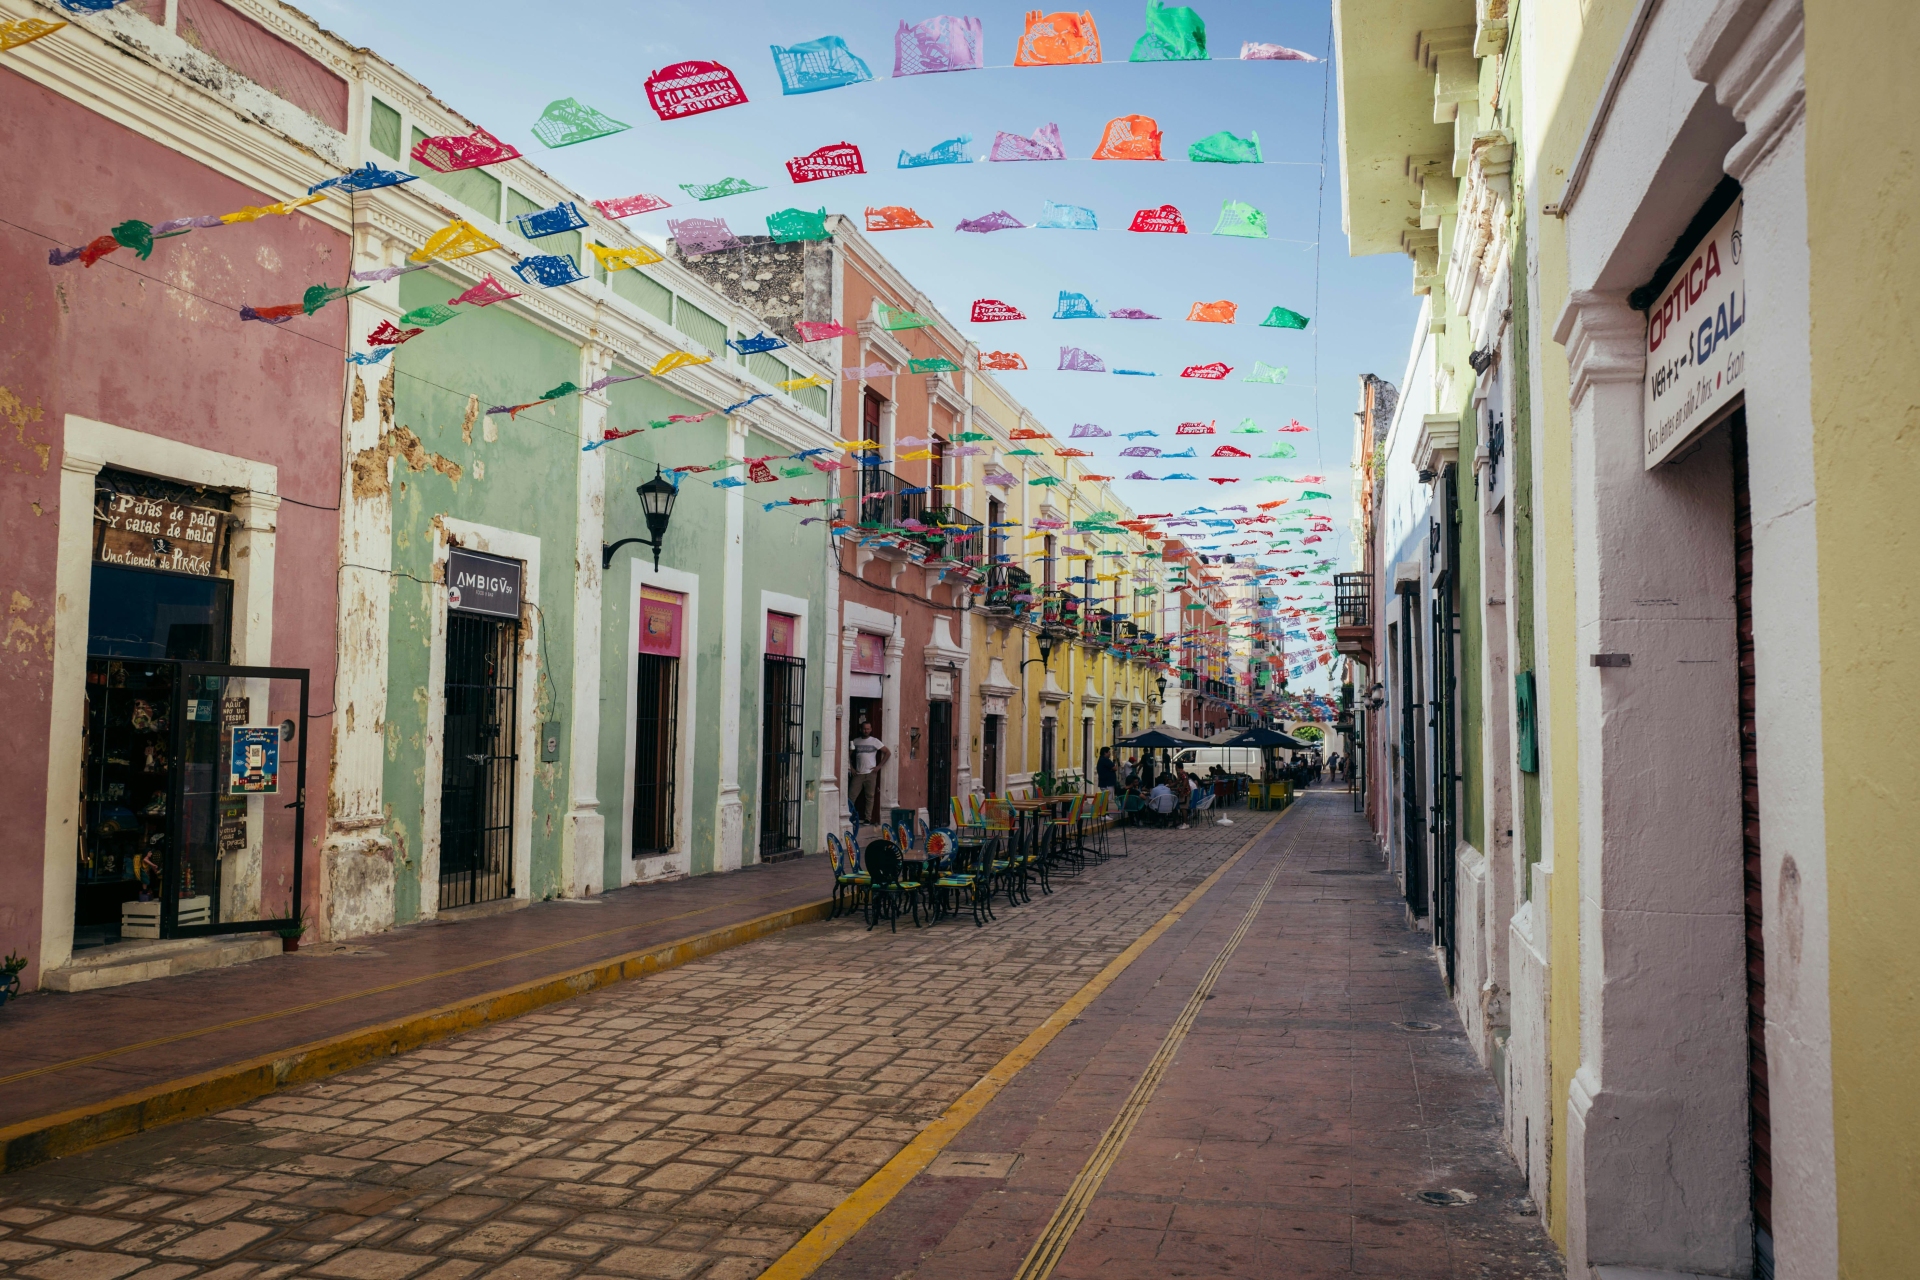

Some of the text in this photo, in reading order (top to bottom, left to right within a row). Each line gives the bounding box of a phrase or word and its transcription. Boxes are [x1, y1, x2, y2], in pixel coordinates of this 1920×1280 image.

[1649, 240, 1721, 353] OPTICA
[1648, 375, 1713, 455] Sus lentes en sólo 2 hrs.
[111, 496, 216, 527] Patas de palo
[125, 517, 161, 535] caras
[166, 522, 181, 538] de
[185, 527, 214, 544] malo
[101, 543, 211, 576] Una tienda de PIRATAS
